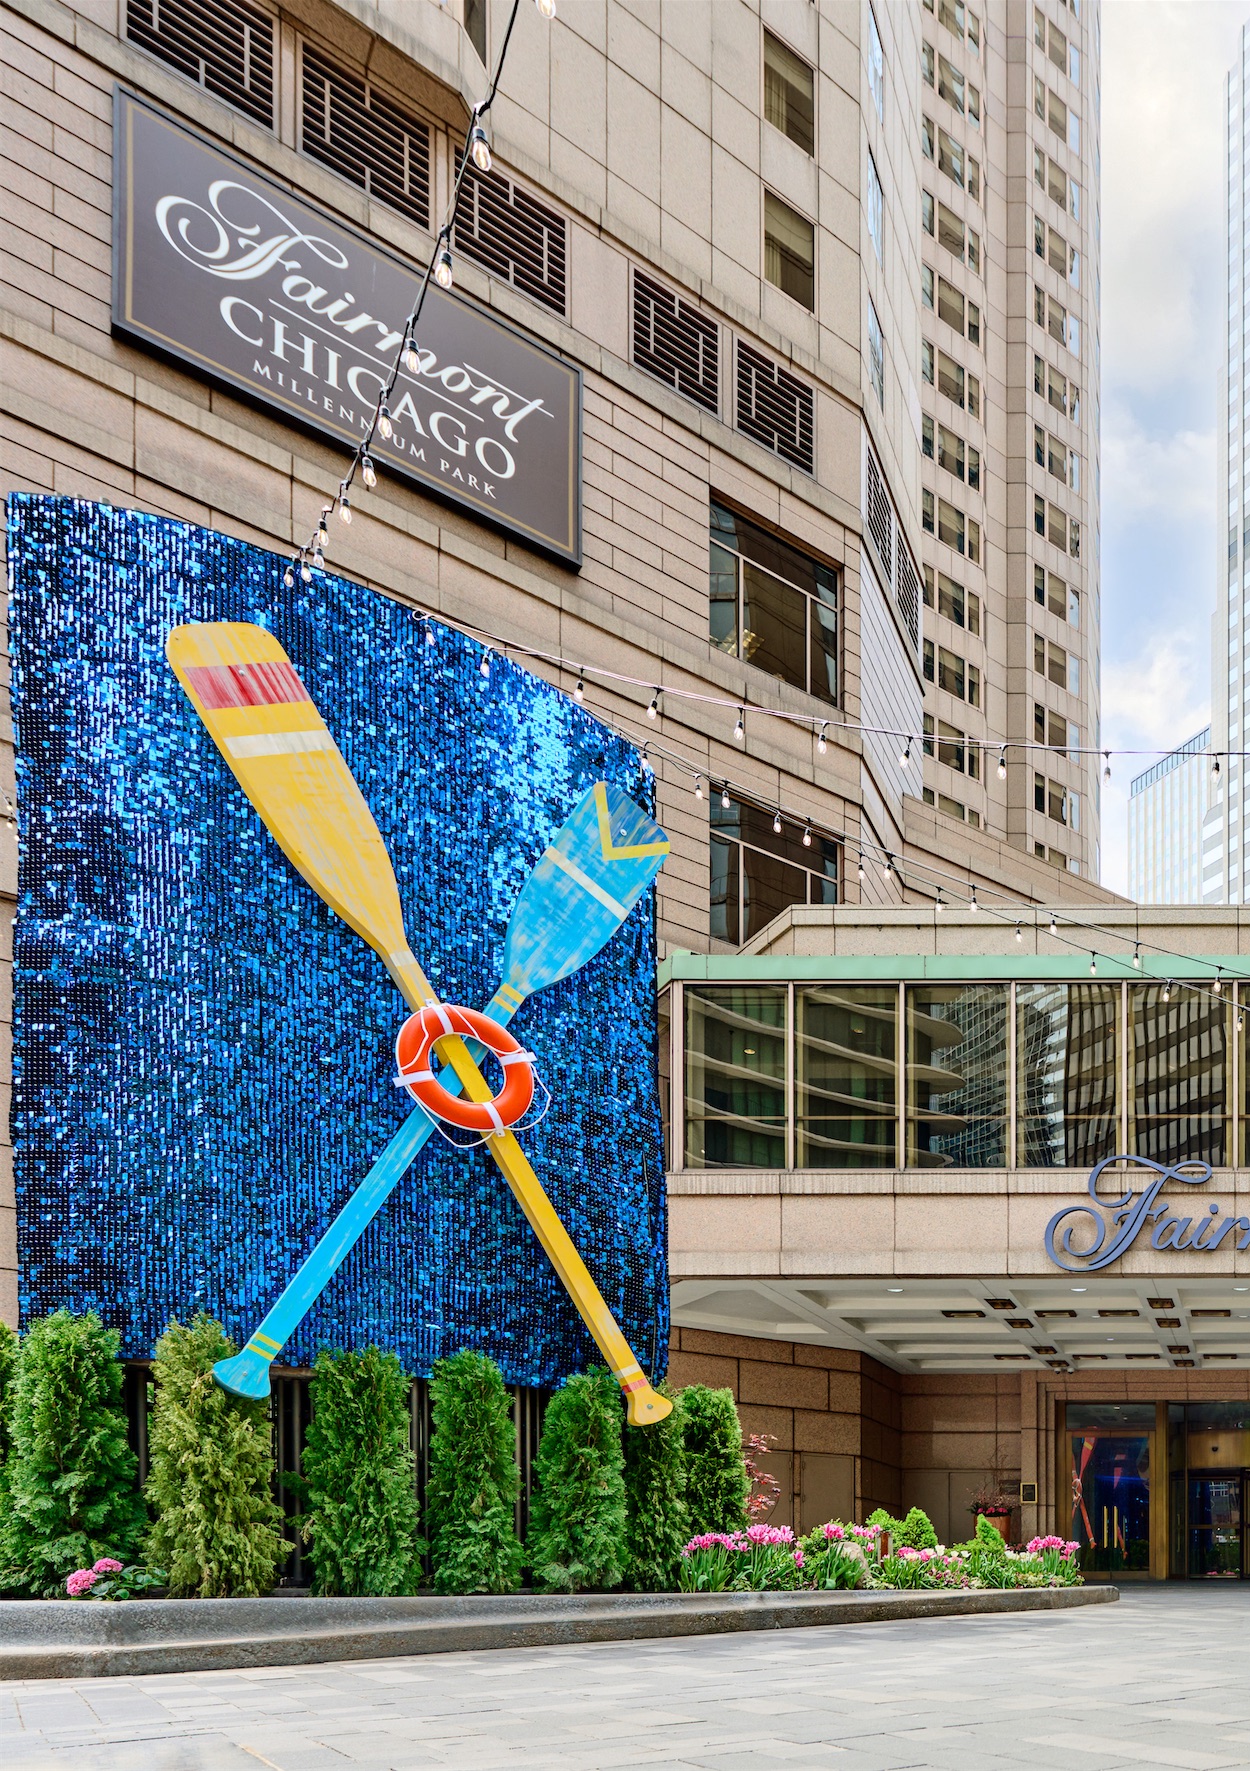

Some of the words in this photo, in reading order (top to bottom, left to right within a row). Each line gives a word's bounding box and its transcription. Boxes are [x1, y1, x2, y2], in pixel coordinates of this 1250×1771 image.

[156, 180, 554, 442] Fairmont
[220, 296, 515, 479] CHICAGO
[253, 359, 427, 461] MILLENNUM
[439, 459, 497, 499] PARK
